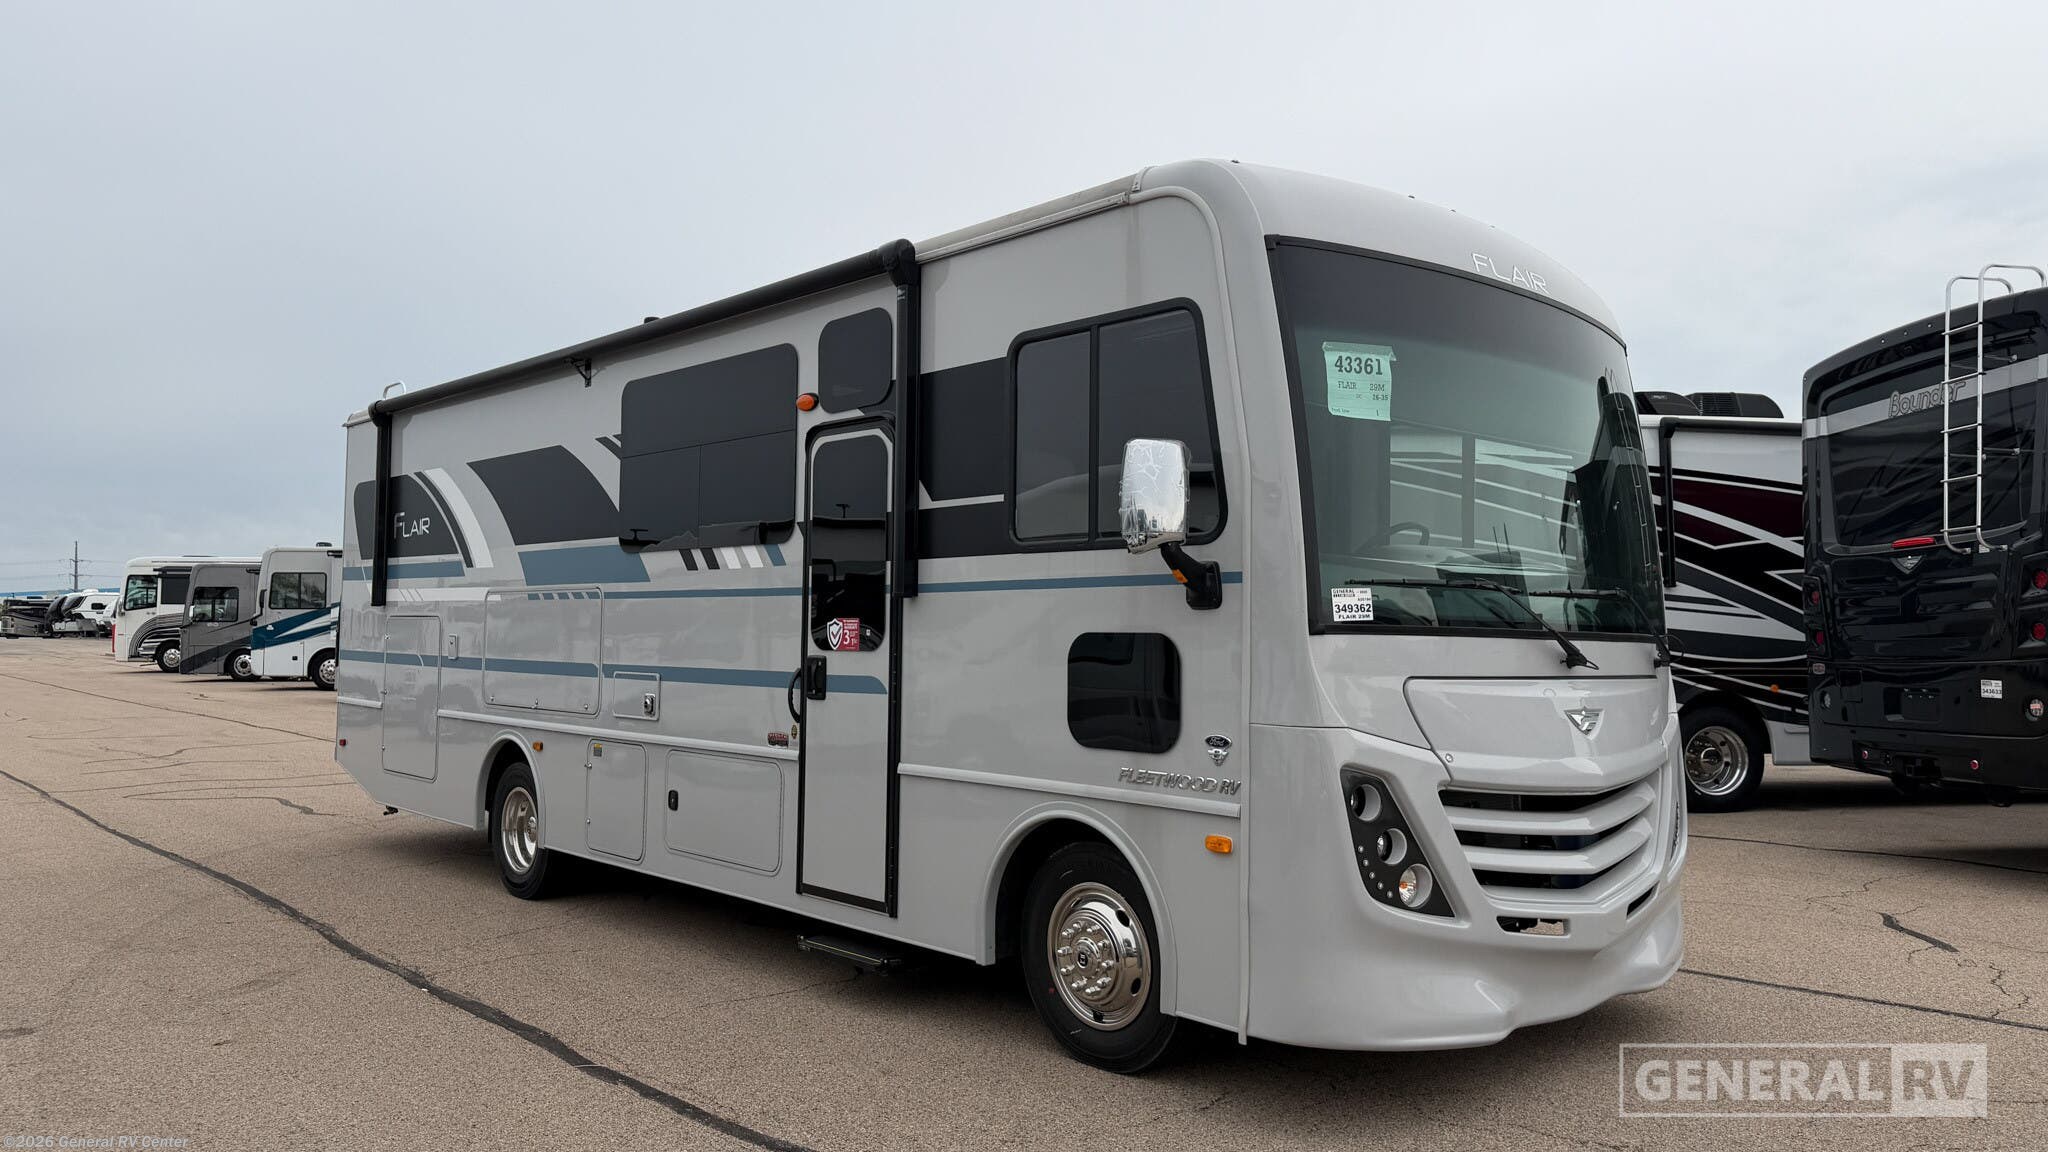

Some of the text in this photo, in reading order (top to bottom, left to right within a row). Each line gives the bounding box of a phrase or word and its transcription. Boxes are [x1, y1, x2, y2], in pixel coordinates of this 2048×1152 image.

[1471, 252, 1551, 295] FLAIR
[1334, 355, 1383, 375] 43361
[1338, 380, 1357, 390] FLAIR
[393, 511, 431, 539] FLAIR
[1334, 603, 1372, 613] 349362
[1119, 767, 1242, 796] FLEETWOOD RV
